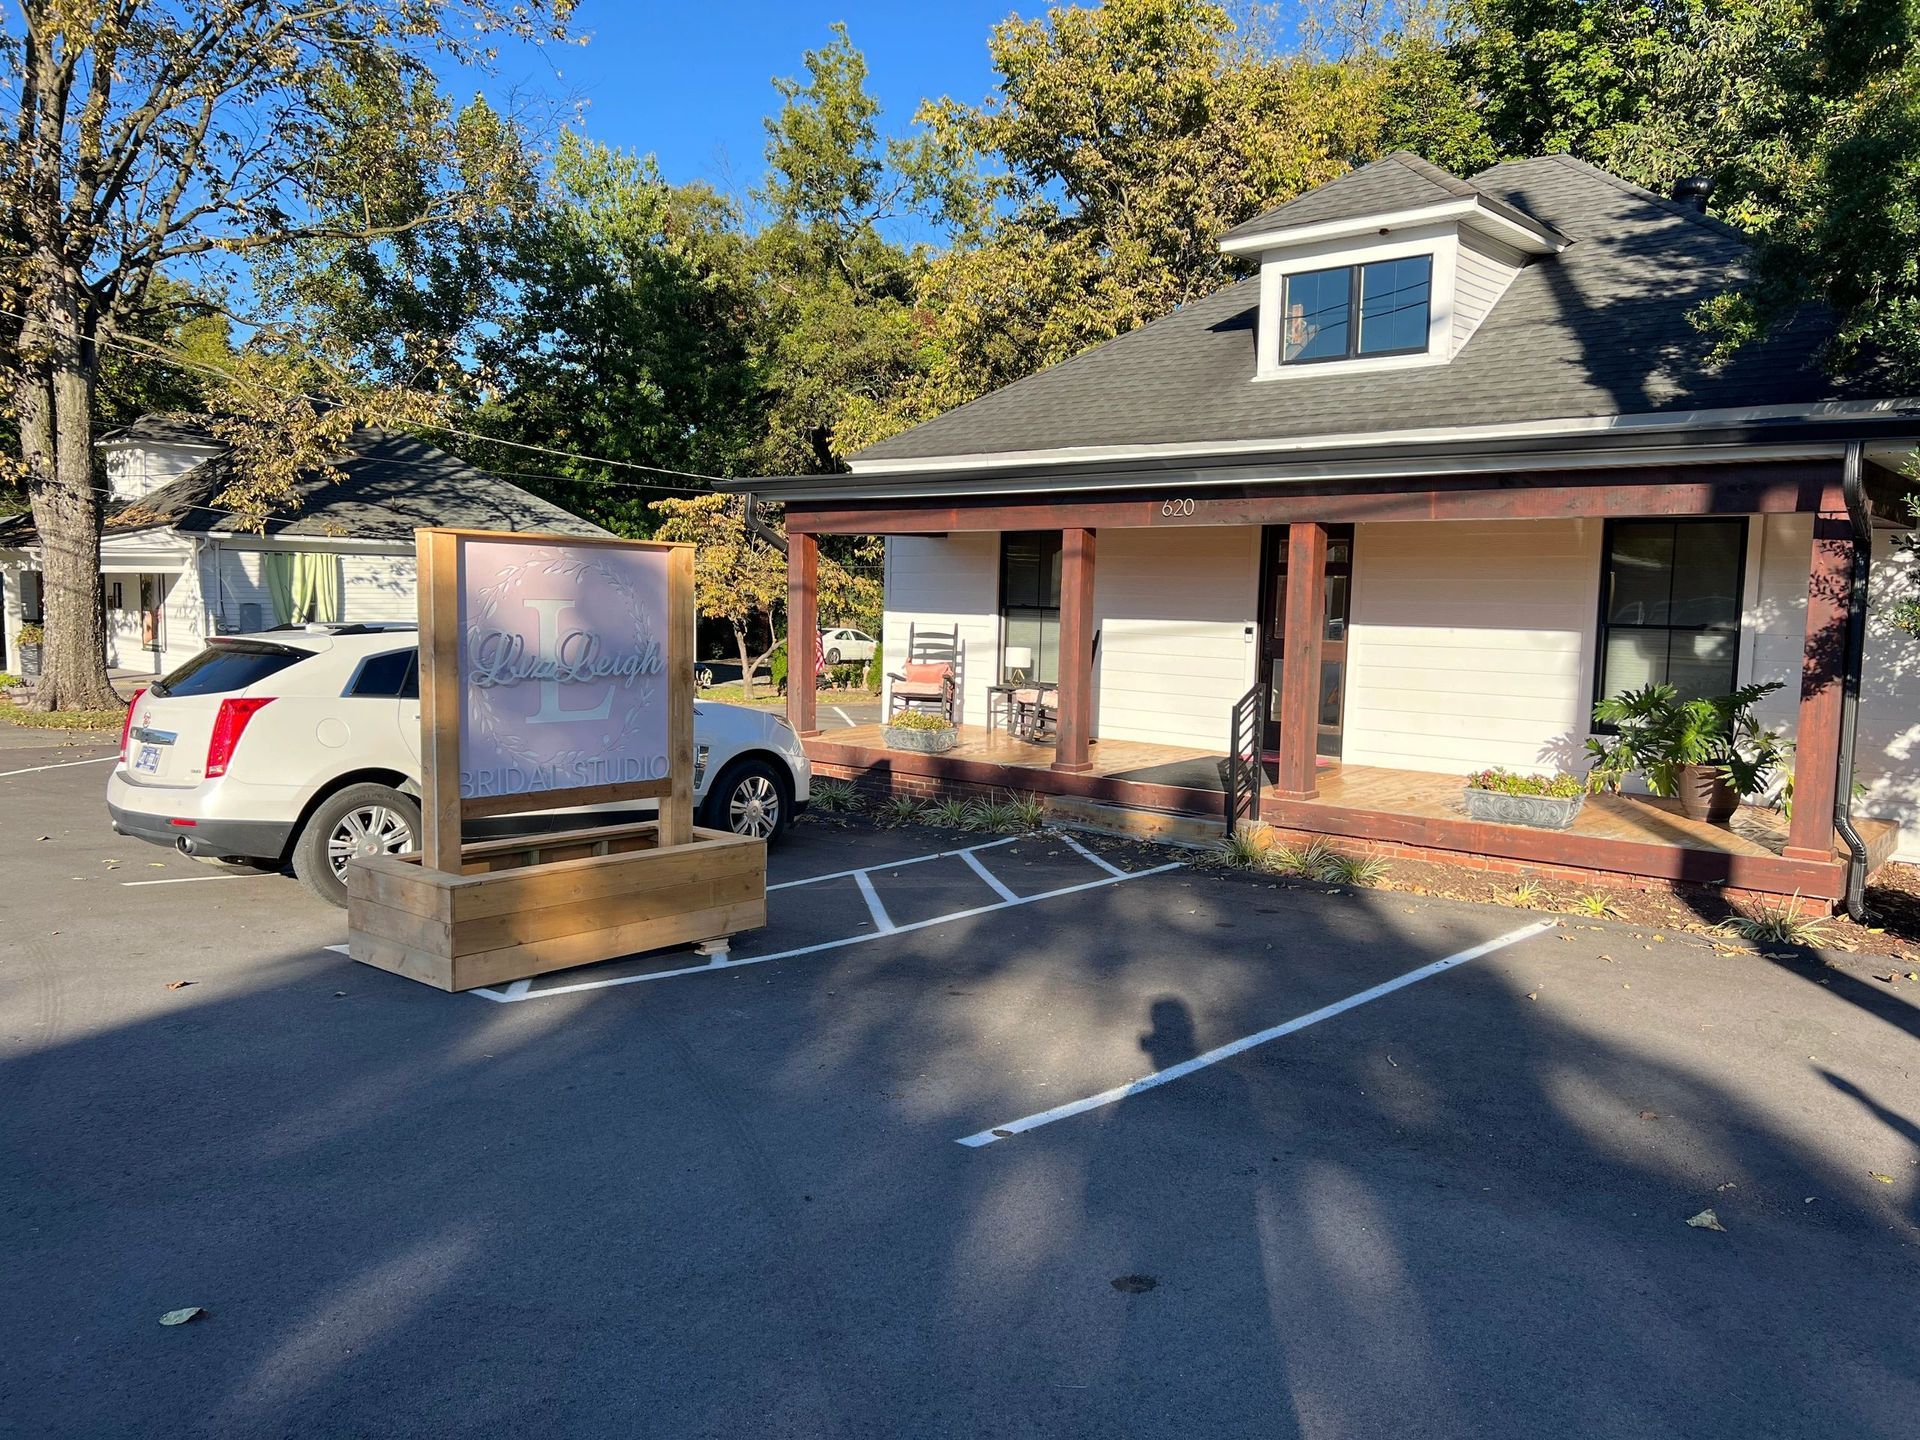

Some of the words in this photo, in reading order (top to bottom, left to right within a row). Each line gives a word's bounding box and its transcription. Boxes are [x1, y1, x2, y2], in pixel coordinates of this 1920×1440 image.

[1162, 498, 1195, 517] 620
[523, 598, 615, 724] L
[553, 629, 662, 688] Leigh
[573, 755, 670, 788] STUDIO
